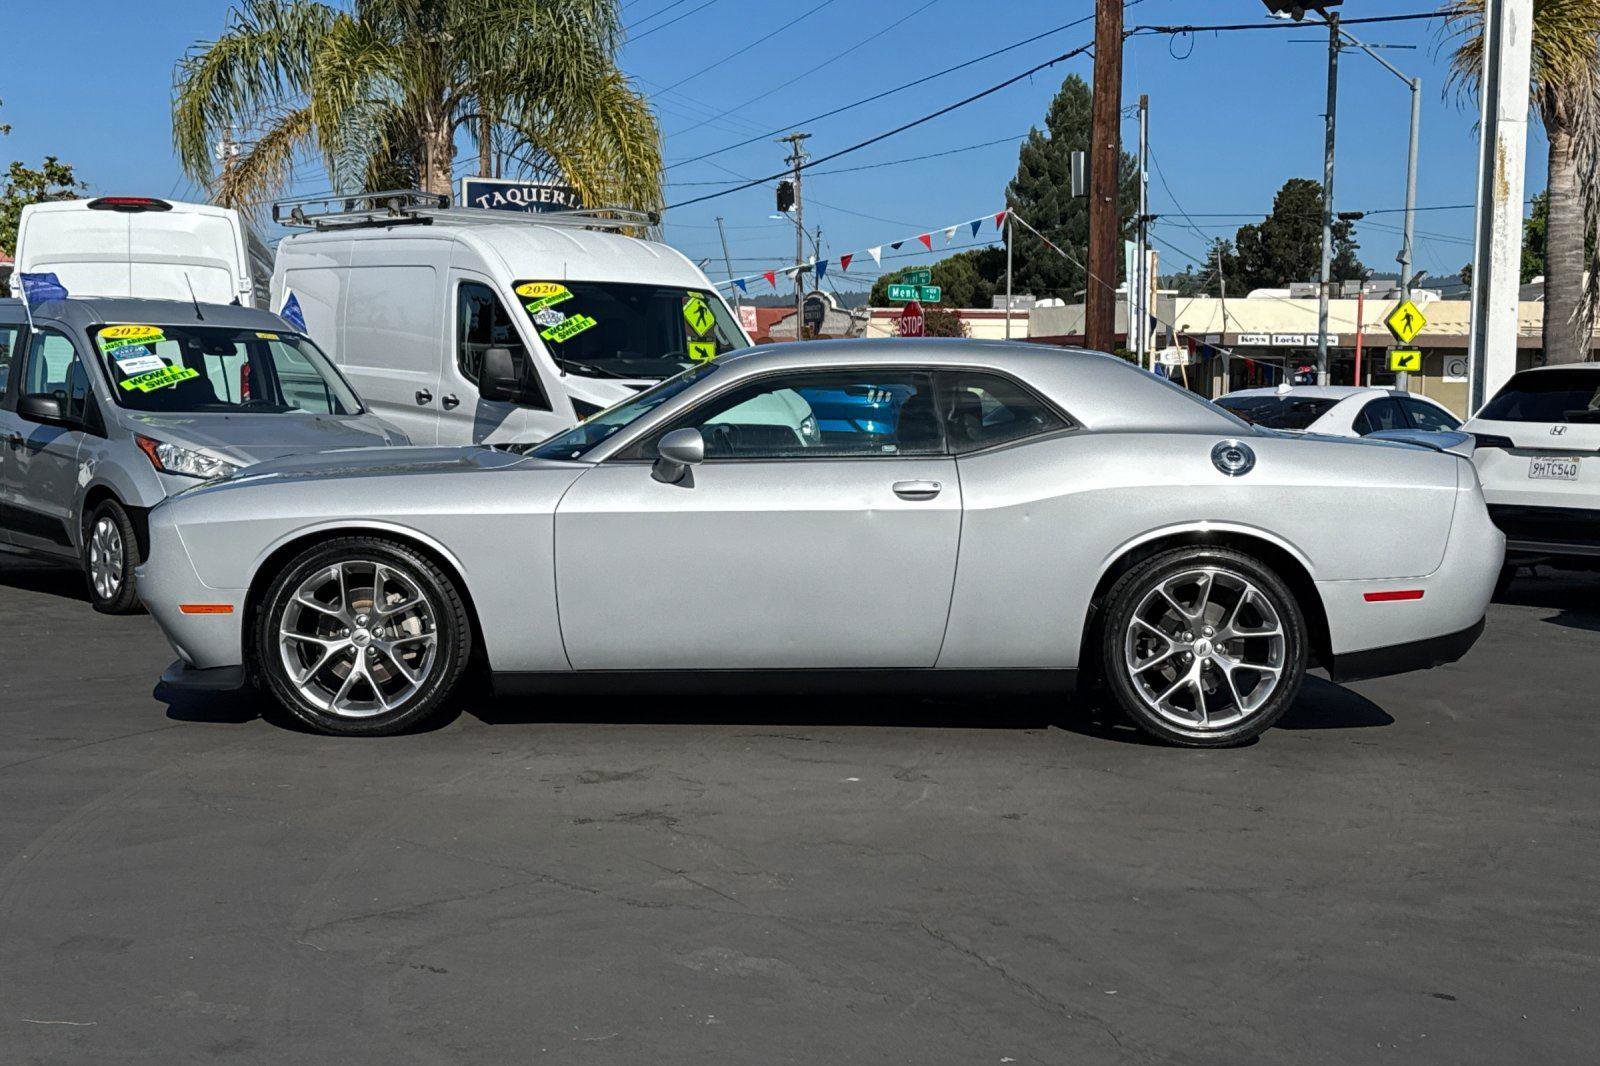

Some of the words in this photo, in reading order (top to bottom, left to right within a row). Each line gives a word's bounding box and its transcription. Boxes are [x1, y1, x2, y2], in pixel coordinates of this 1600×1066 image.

[475, 187, 584, 210] TAQUERI
[524, 284, 558, 296] 2020
[902, 316, 923, 334] STOP
[110, 327, 151, 337] 2022
[104, 340, 124, 351] JUST
[1241, 336, 1266, 344] Keys
[1532, 463, 1576, 476] 9HTC540
